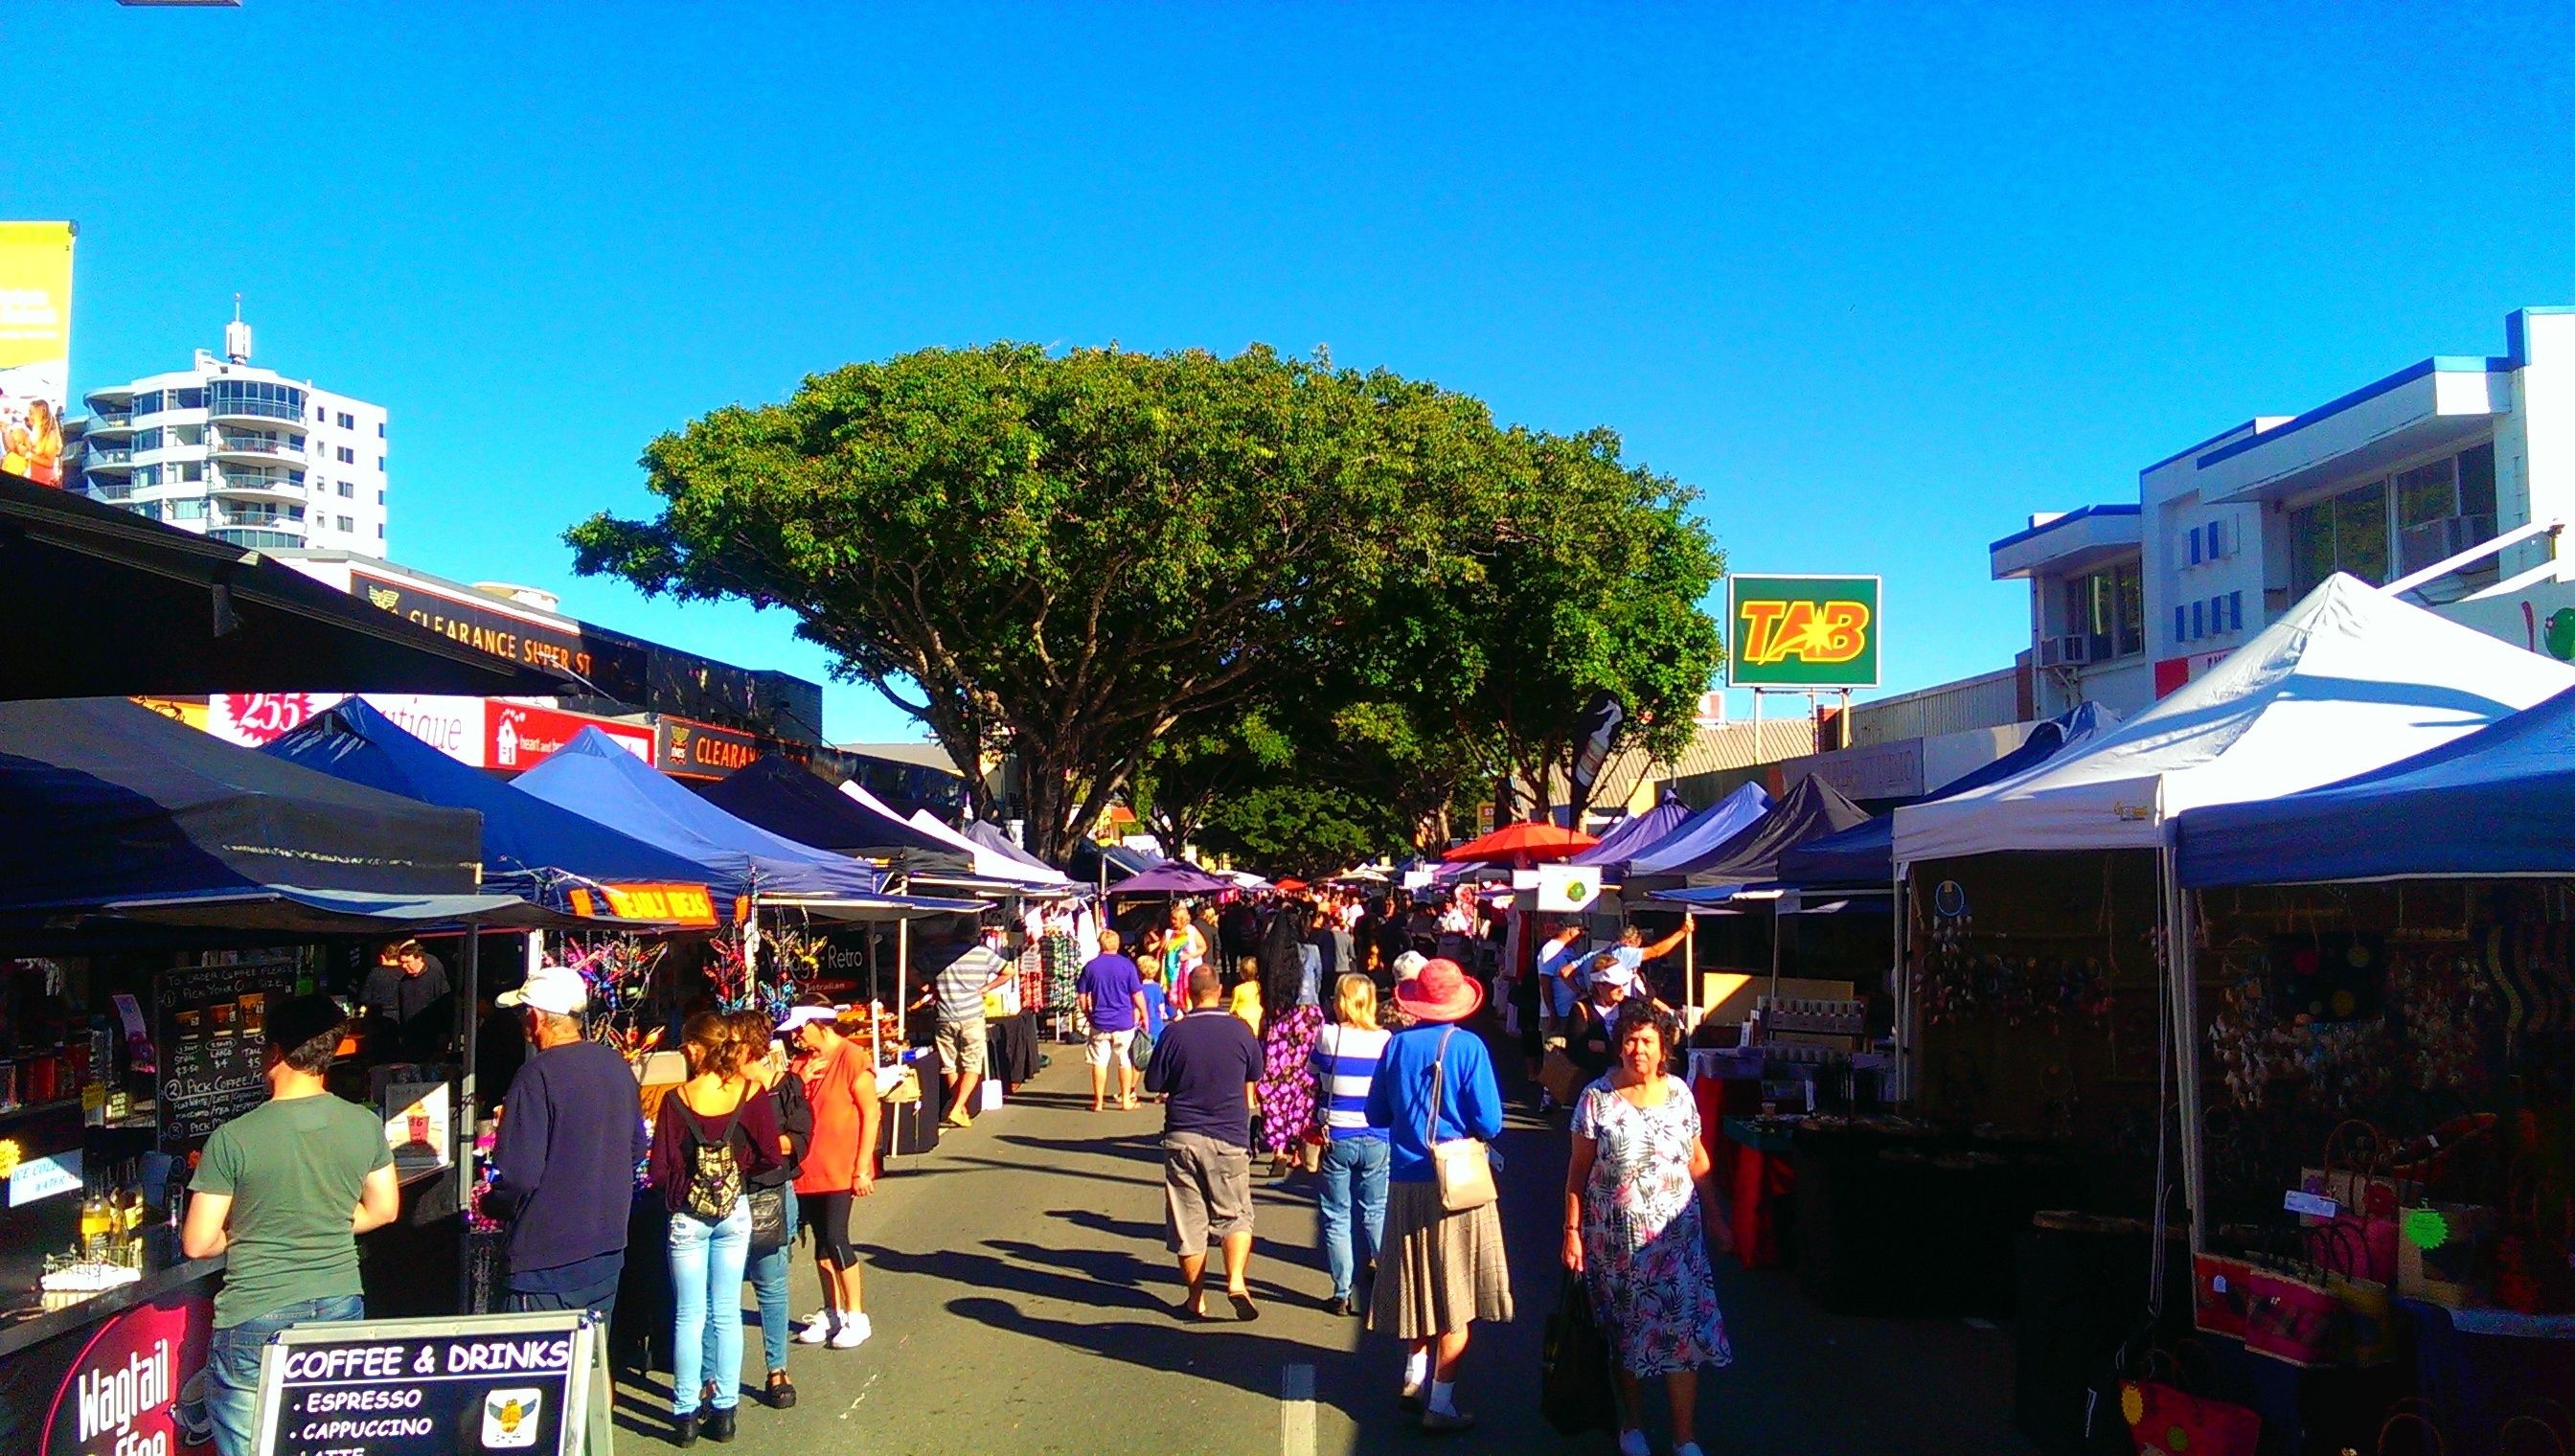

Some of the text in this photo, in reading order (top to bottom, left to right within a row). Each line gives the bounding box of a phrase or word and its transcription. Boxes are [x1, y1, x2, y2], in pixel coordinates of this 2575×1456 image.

[1741, 601, 1870, 664] TAB
[519, 734, 540, 752] heart
[828, 944, 863, 969] Retro
[214, 1058, 229, 1070] $4
[247, 1057, 262, 1069] $5
[187, 1079, 212, 1095] PICK
[284, 1341, 570, 1379] COFFEE & DRINKS
[79, 1338, 170, 1443] Wagtail
[307, 1389, 422, 1413] ESPRESSO
[303, 1418, 433, 1441] CAPPUCCINO
